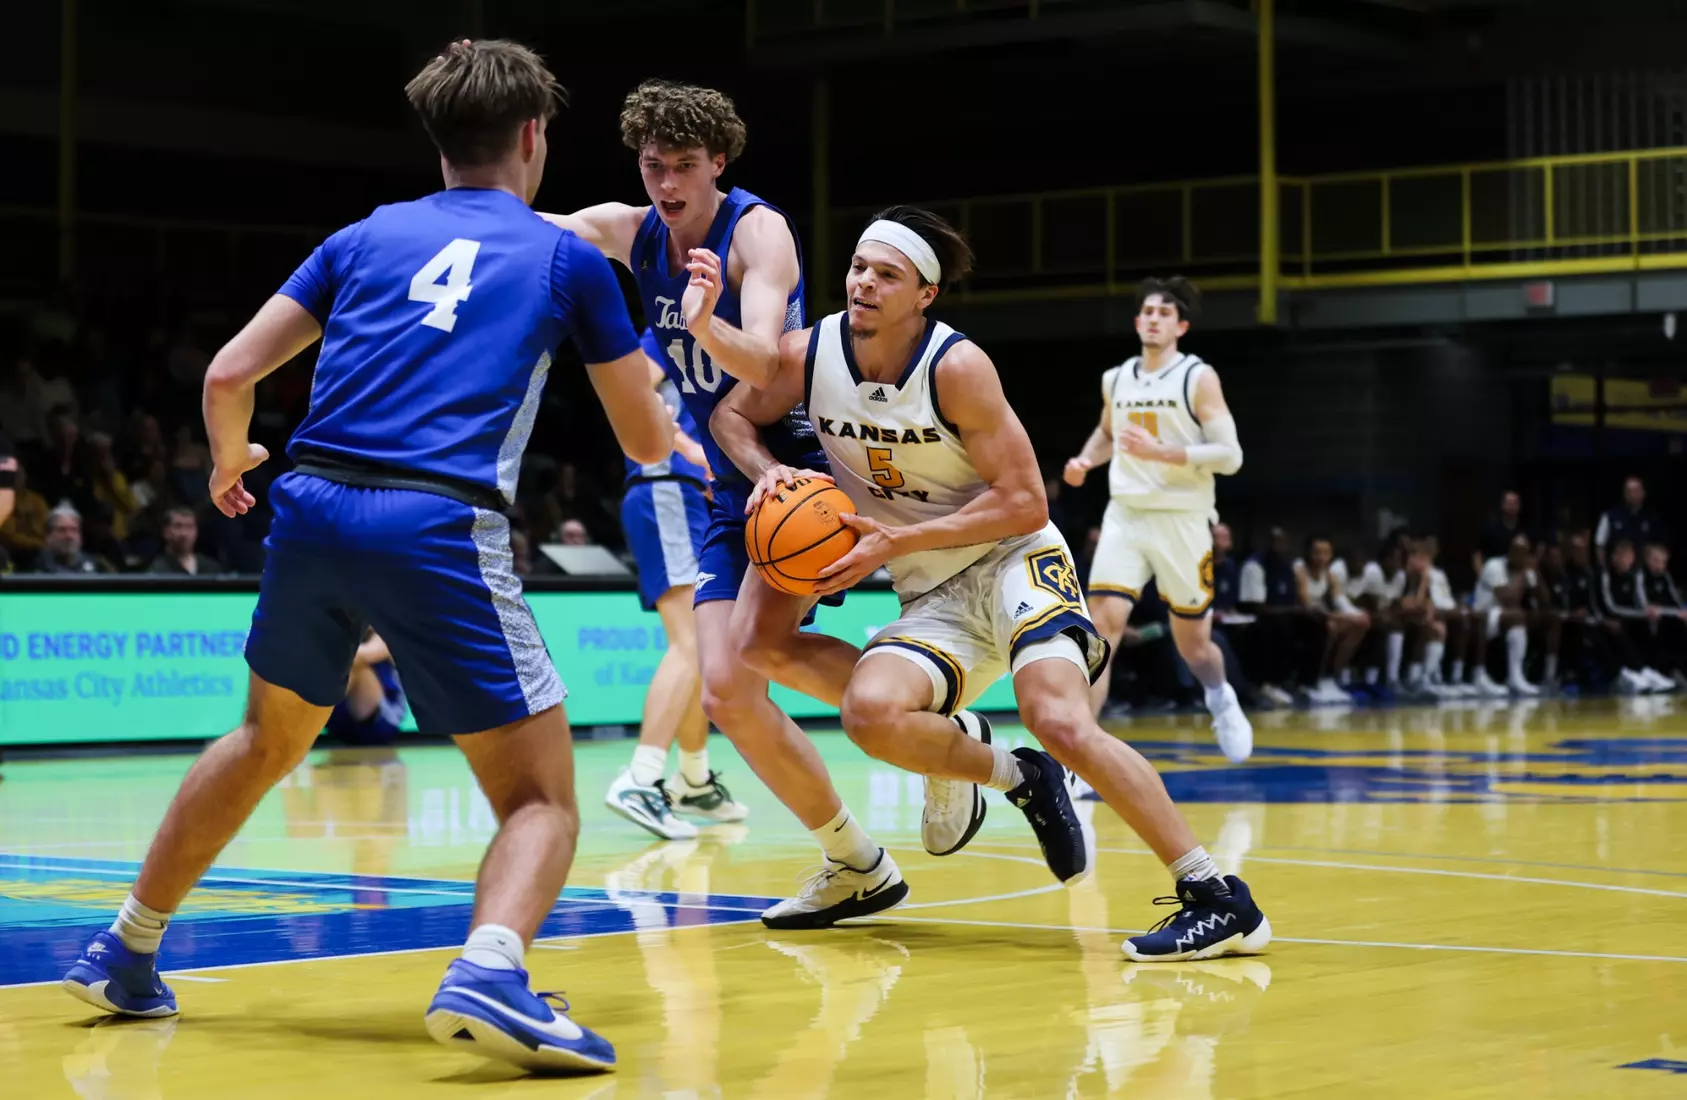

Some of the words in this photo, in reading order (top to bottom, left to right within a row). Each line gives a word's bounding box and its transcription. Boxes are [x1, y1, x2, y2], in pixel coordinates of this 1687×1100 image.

[407, 237, 481, 334] 4
[666, 338, 723, 395] 10
[868, 394, 888, 404] adidas
[817, 416, 942, 444] KANSAS
[866, 446, 905, 488] 5
[27, 631, 128, 660] ENERGY
[578, 626, 648, 651] PROUD
[74, 671, 125, 707] City
[130, 669, 234, 698] Athletics
